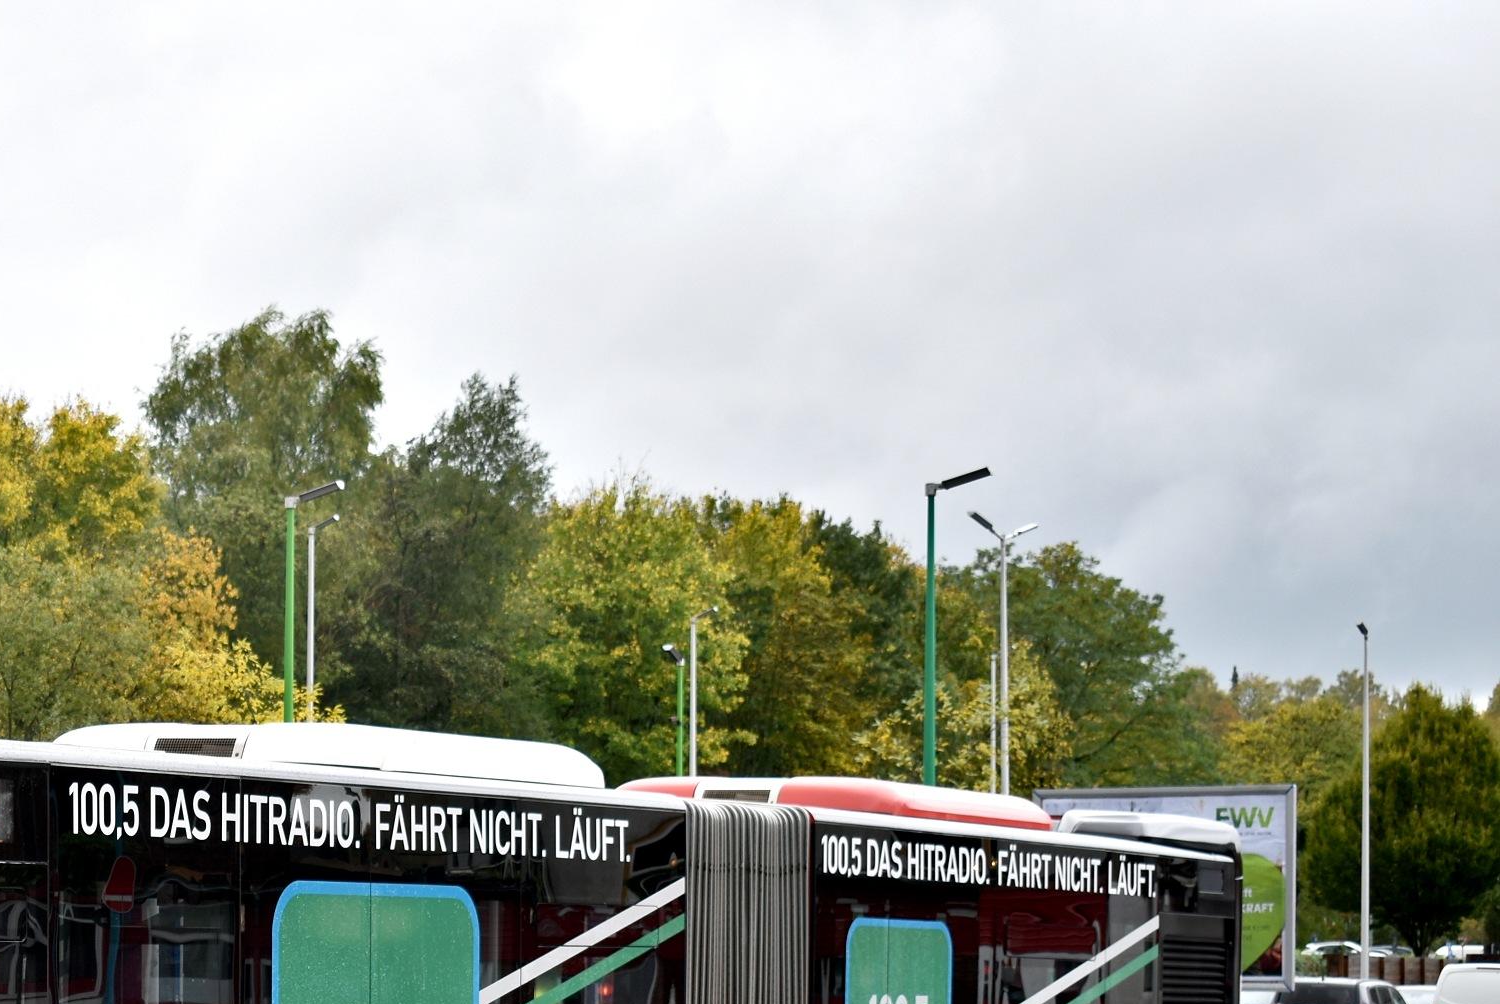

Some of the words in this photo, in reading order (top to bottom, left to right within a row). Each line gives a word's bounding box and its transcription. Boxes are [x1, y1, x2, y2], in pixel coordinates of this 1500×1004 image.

[68, 782, 140, 840] 100,5
[150, 787, 212, 841] DAS
[221, 792, 360, 849] HITRADIO.
[375, 794, 463, 852] FÄHRT
[469, 808, 546, 857] NICHT.
[555, 807, 631, 862] LÄUFT.
[821, 835, 862, 878] 100,5
[866, 839, 901, 878] DAS
[907, 842, 990, 885] HITRADIO.
[997, 845, 1051, 890] FÄHRT
[1055, 855, 1104, 893] NICHT.
[1107, 855, 1156, 898] LÄUFT.
